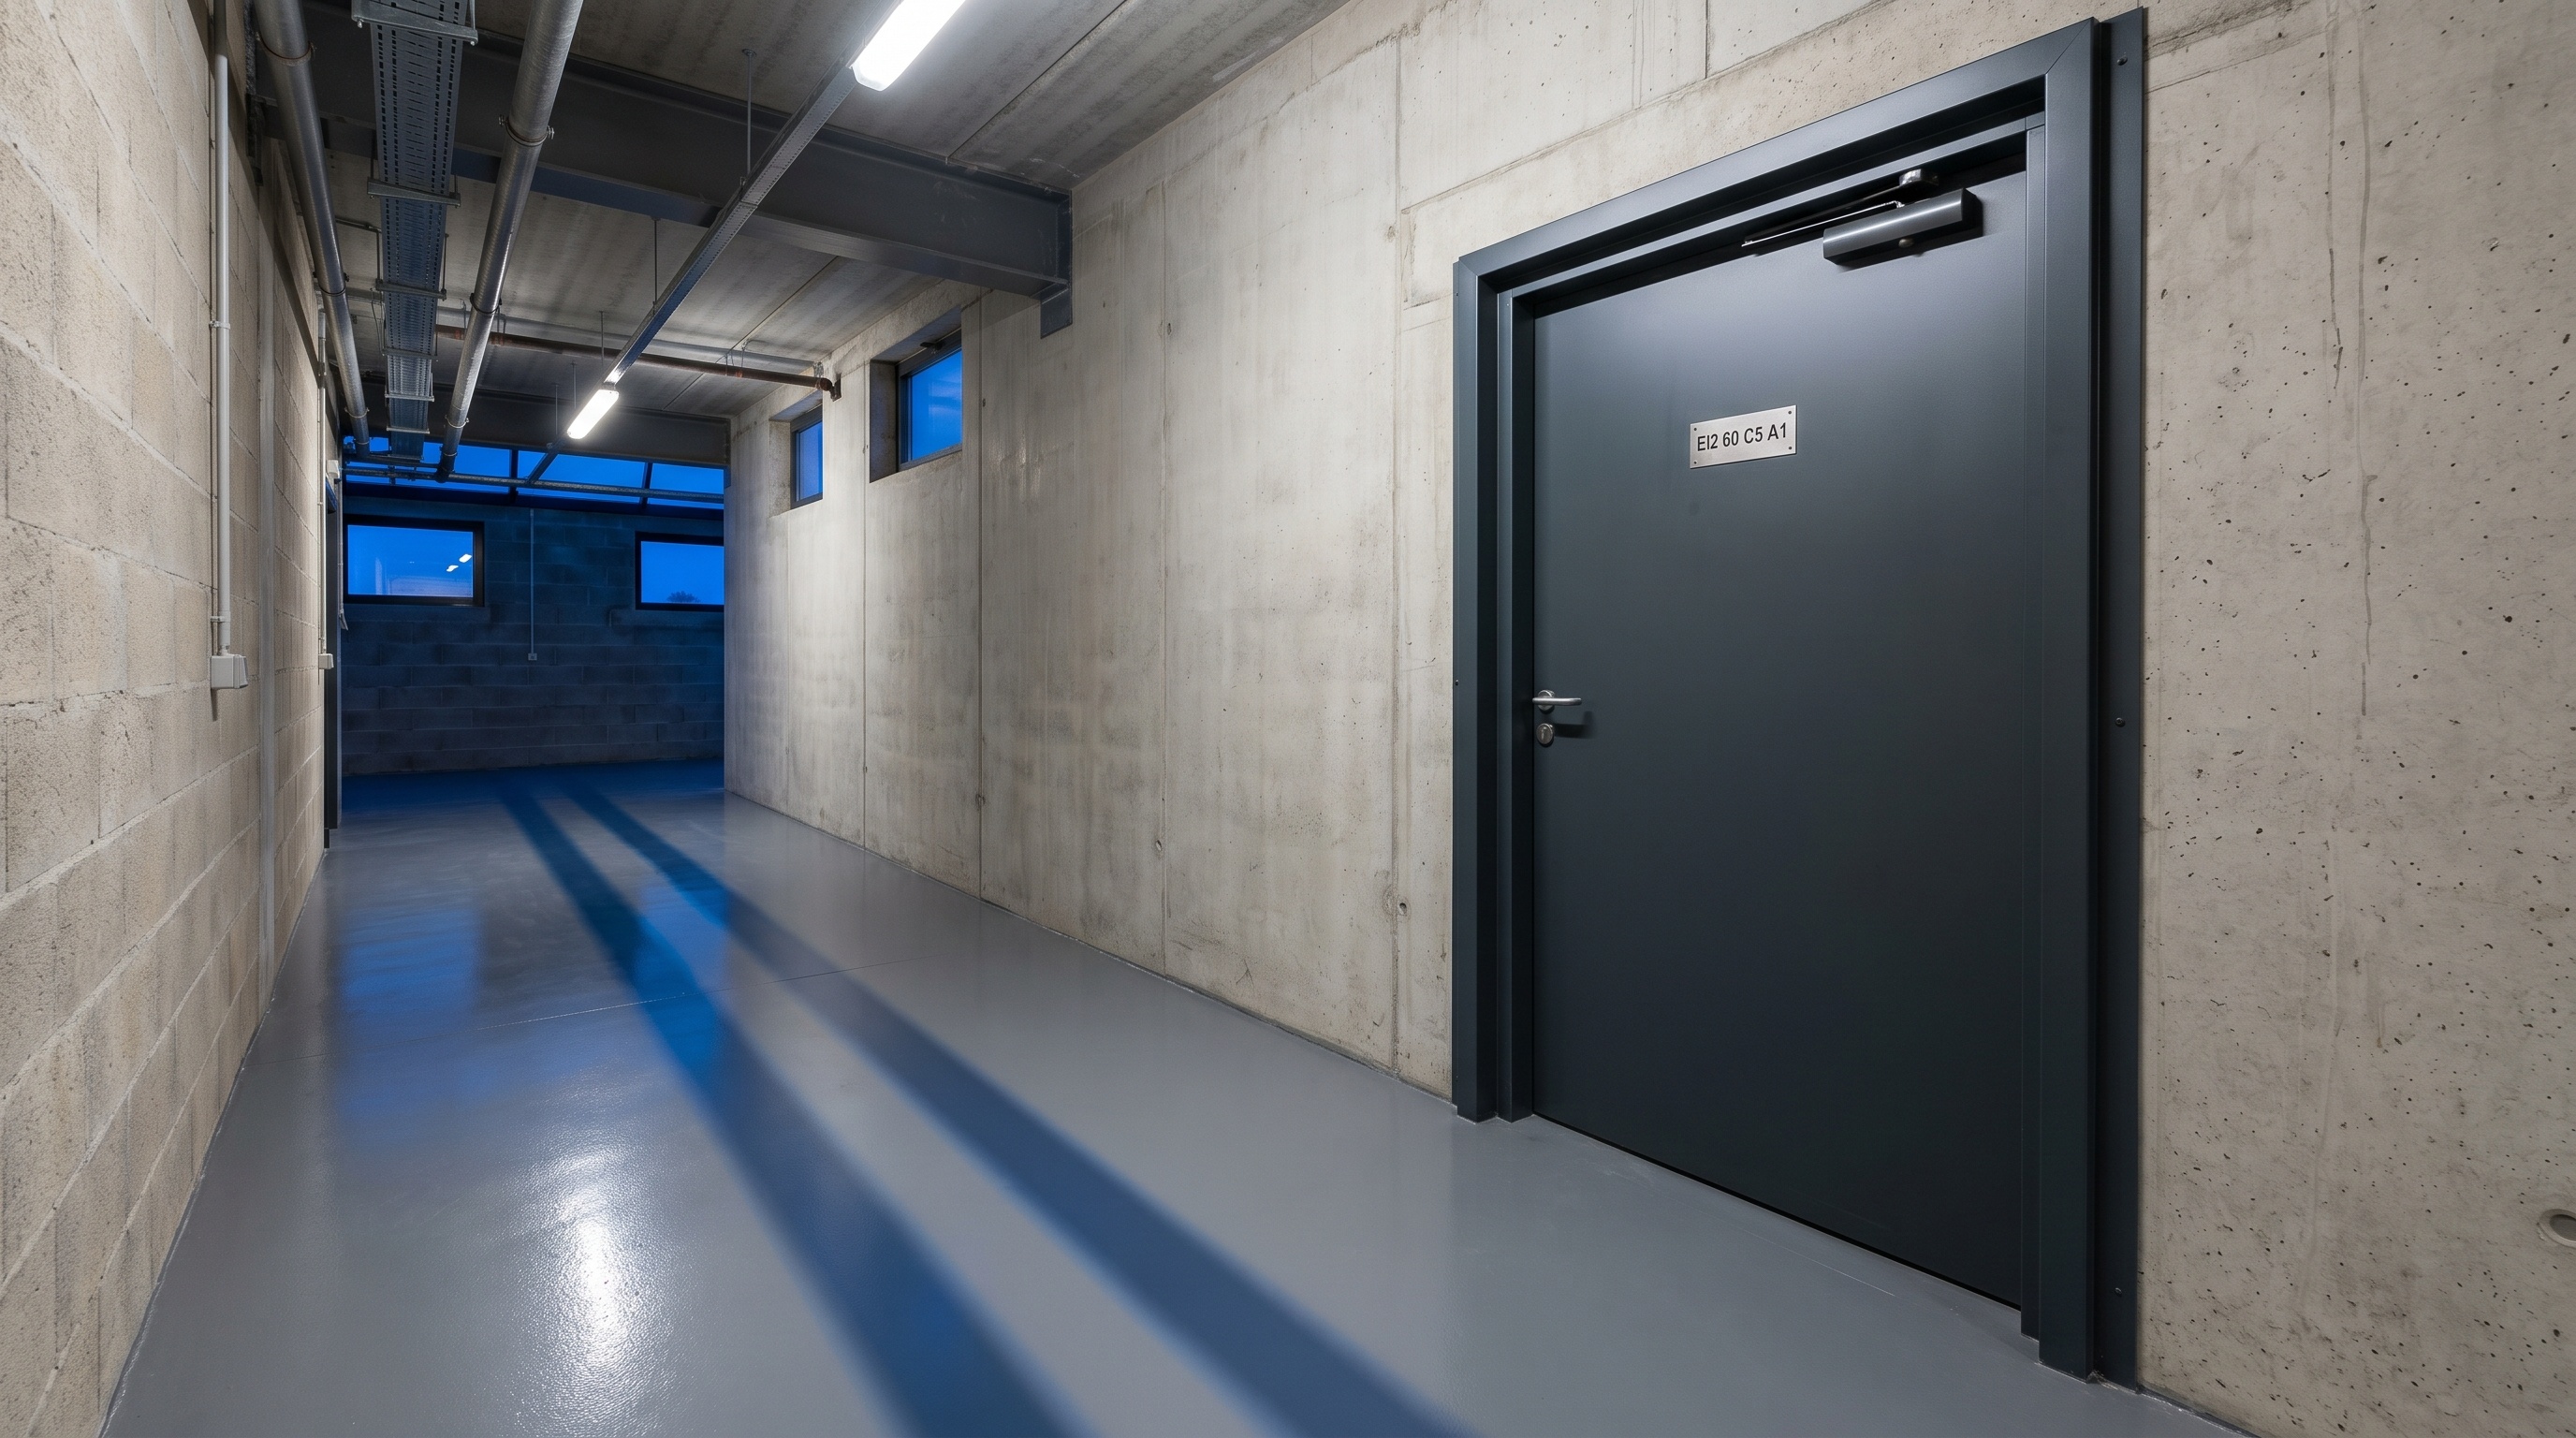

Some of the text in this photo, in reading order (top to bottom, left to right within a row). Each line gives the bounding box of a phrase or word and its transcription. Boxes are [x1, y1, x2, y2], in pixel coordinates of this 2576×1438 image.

[1697, 422, 1786, 451] EI2 60 C5 A1
